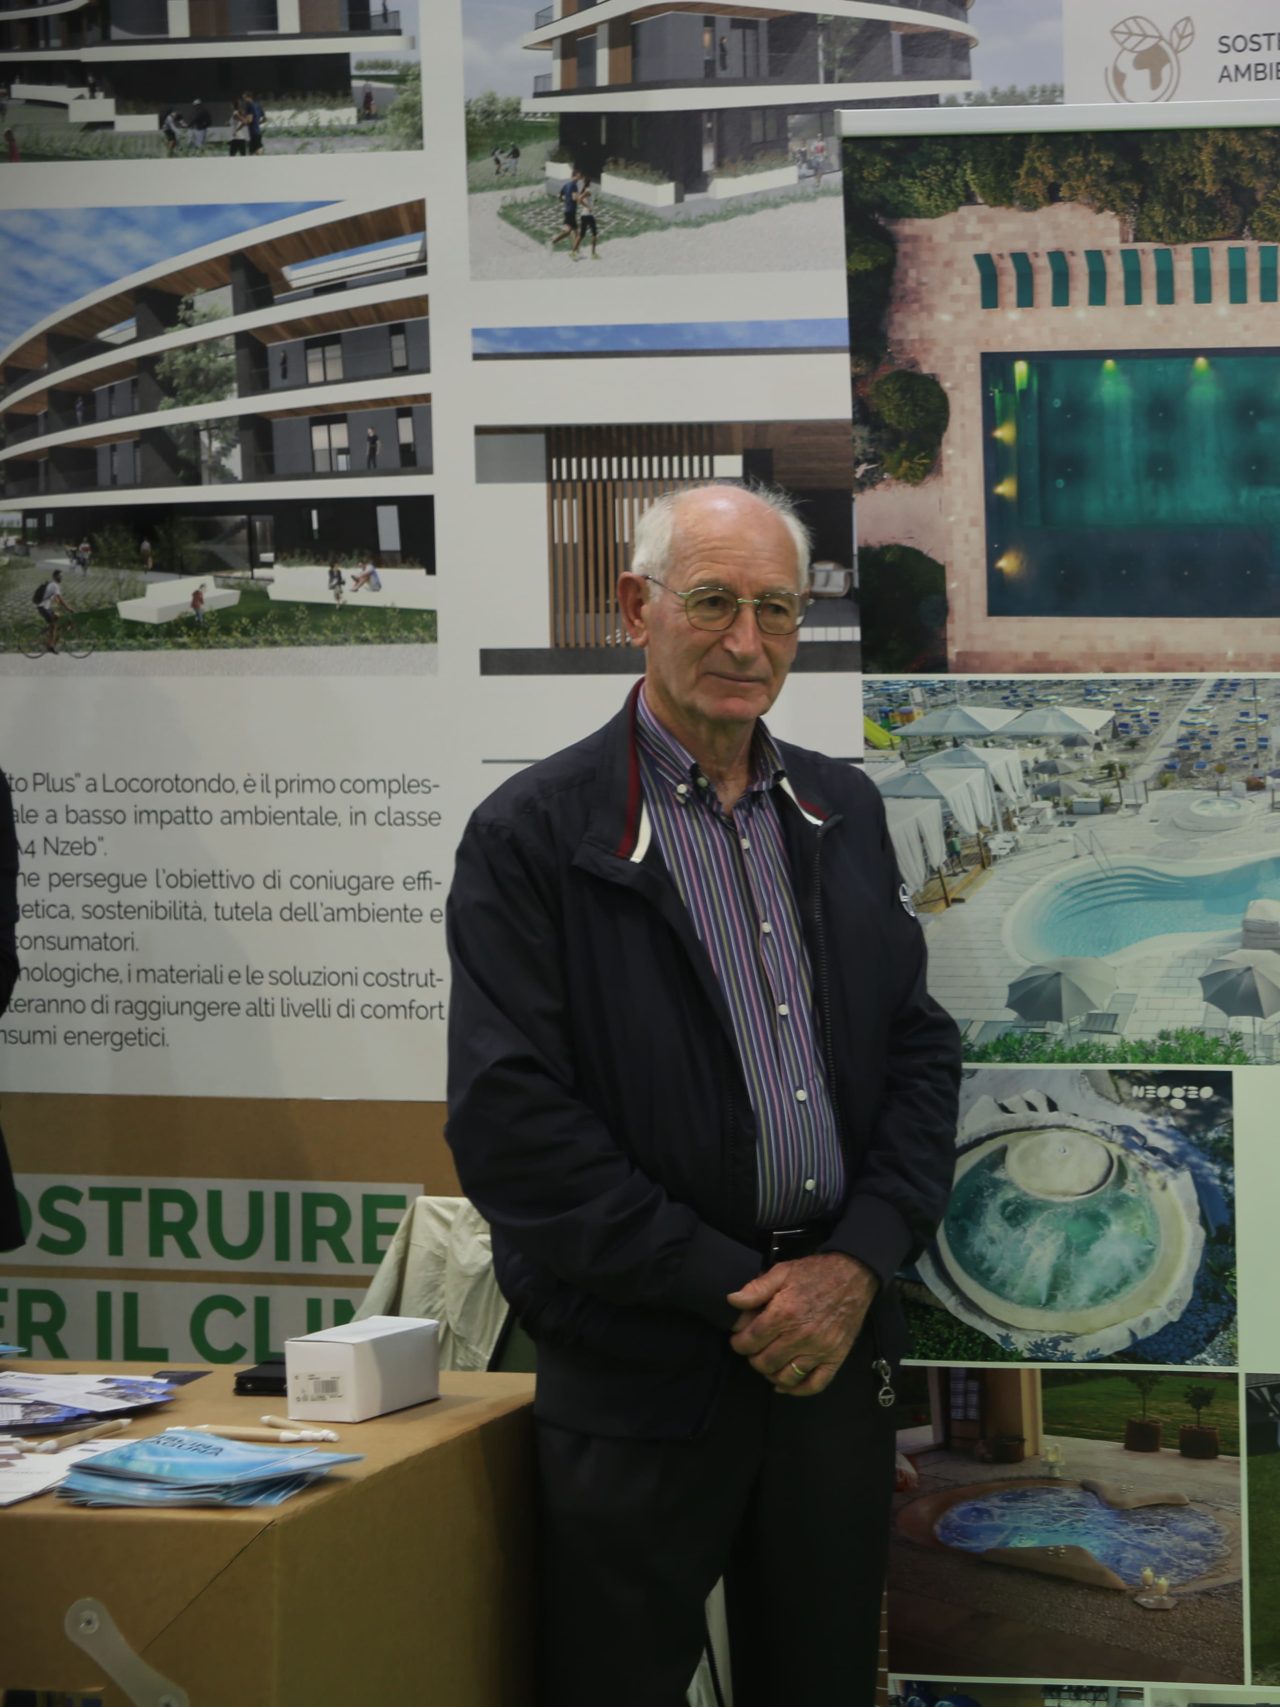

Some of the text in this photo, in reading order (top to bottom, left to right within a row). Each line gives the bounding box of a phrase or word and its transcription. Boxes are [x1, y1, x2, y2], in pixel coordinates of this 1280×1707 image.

[85, 777, 98, 793] a
[102, 772, 239, 795] Locorotondo,
[243, 773, 257, 794] è
[260, 773, 271, 794] il
[275, 773, 336, 799] primo
[340, 773, 440, 799] comples-
[45, 808, 58, 824] a
[65, 804, 127, 825] basso
[134, 804, 213, 830] impatto
[220, 804, 341, 828] ambientale,
[349, 806, 367, 827] in
[374, 806, 442, 828] classe
[48, 871, 148, 894] persegue
[263, 869, 282, 890] di
[289, 870, 395, 896] coniugare
[402, 870, 442, 892] effi-
[18, 899, 444, 924] etica, sostenibilità, tutela dell'ambiente e
[127, 963, 132, 984] i
[136, 964, 224, 985] materiali
[228, 969, 242, 986] e
[246, 965, 265, 986] le
[268, 965, 358, 987] soluzioni
[362, 967, 444, 989] costrut-
[91, 994, 109, 1015] di
[114, 995, 242, 1022] raggiungere
[245, 996, 275, 1018] alti
[280, 997, 332, 1018] livelli
[336, 999, 355, 1020] di
[360, 999, 445, 1021] comfort
[63, 1026, 169, 1052] energetici.
[0, 1185, 407, 1265] STRUIRE
[96, 1290, 169, 1363] IL
